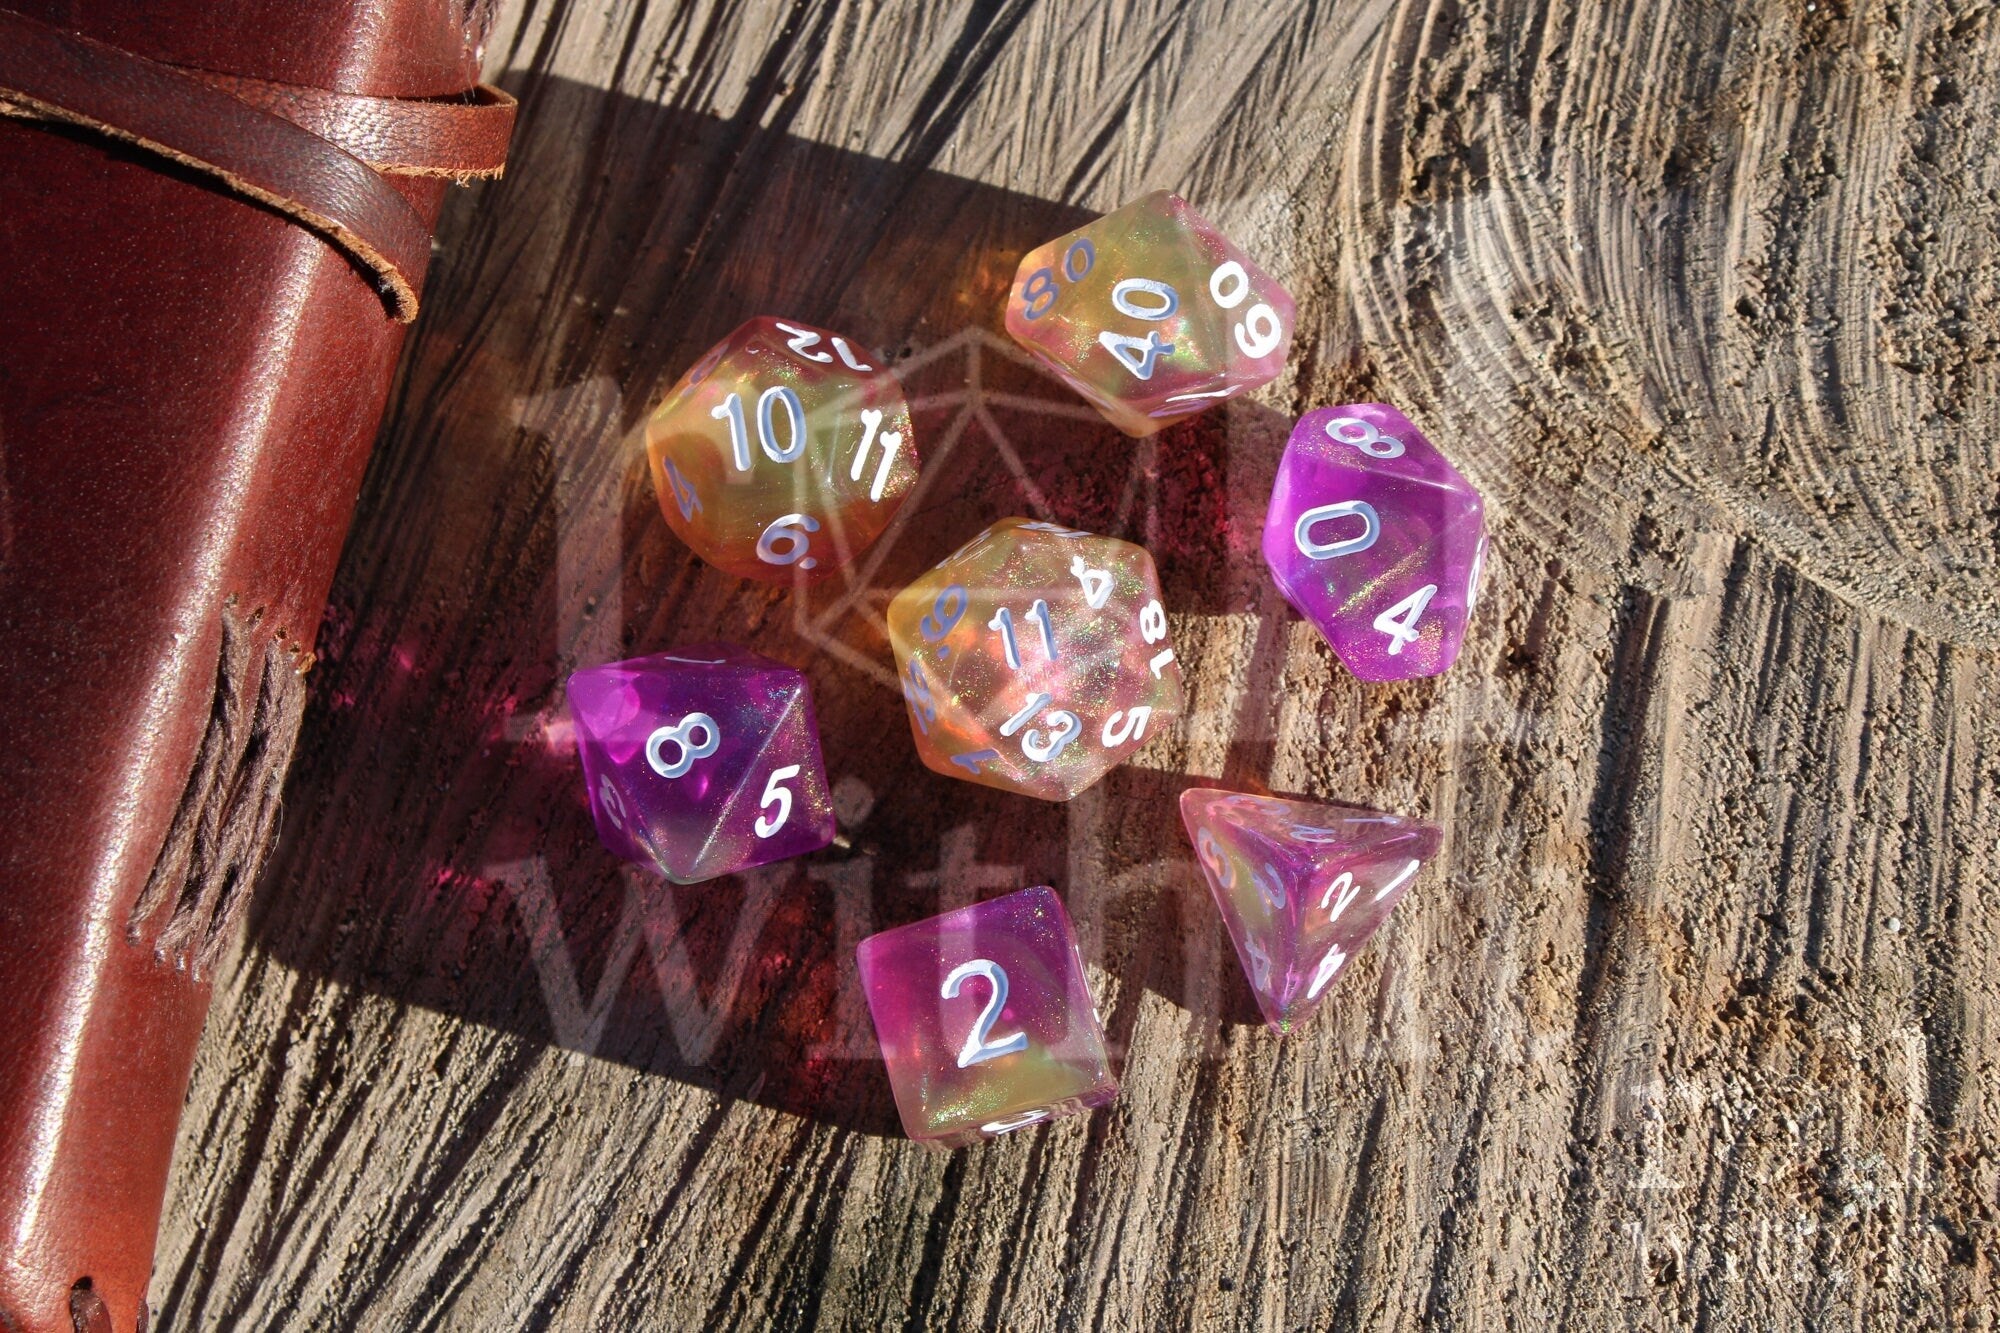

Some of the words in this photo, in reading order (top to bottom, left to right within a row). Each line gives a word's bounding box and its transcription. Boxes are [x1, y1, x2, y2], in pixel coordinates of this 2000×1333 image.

[1021, 237, 1097, 321] 80
[1098, 278, 1180, 380] 40
[711, 385, 807, 472] 10
[850, 409, 901, 502] 11
[1325, 417, 1406, 459] 8
[663, 456, 703, 522] 4
[1294, 500, 1381, 559] 0
[1070, 555, 1116, 609] 4
[988, 599, 1058, 670] 11
[1139, 600, 1175, 680] 18
[1373, 583, 1438, 656] 4
[645, 712, 721, 779] 8
[1000, 693, 1083, 762] 13
[1101, 705, 1152, 748] 5
[754, 764, 801, 838] 5
[1320, 871, 1361, 922] 2
[1374, 859, 1420, 900] 1
[1306, 943, 1347, 999] 4
[941, 958, 1029, 1068] 2
